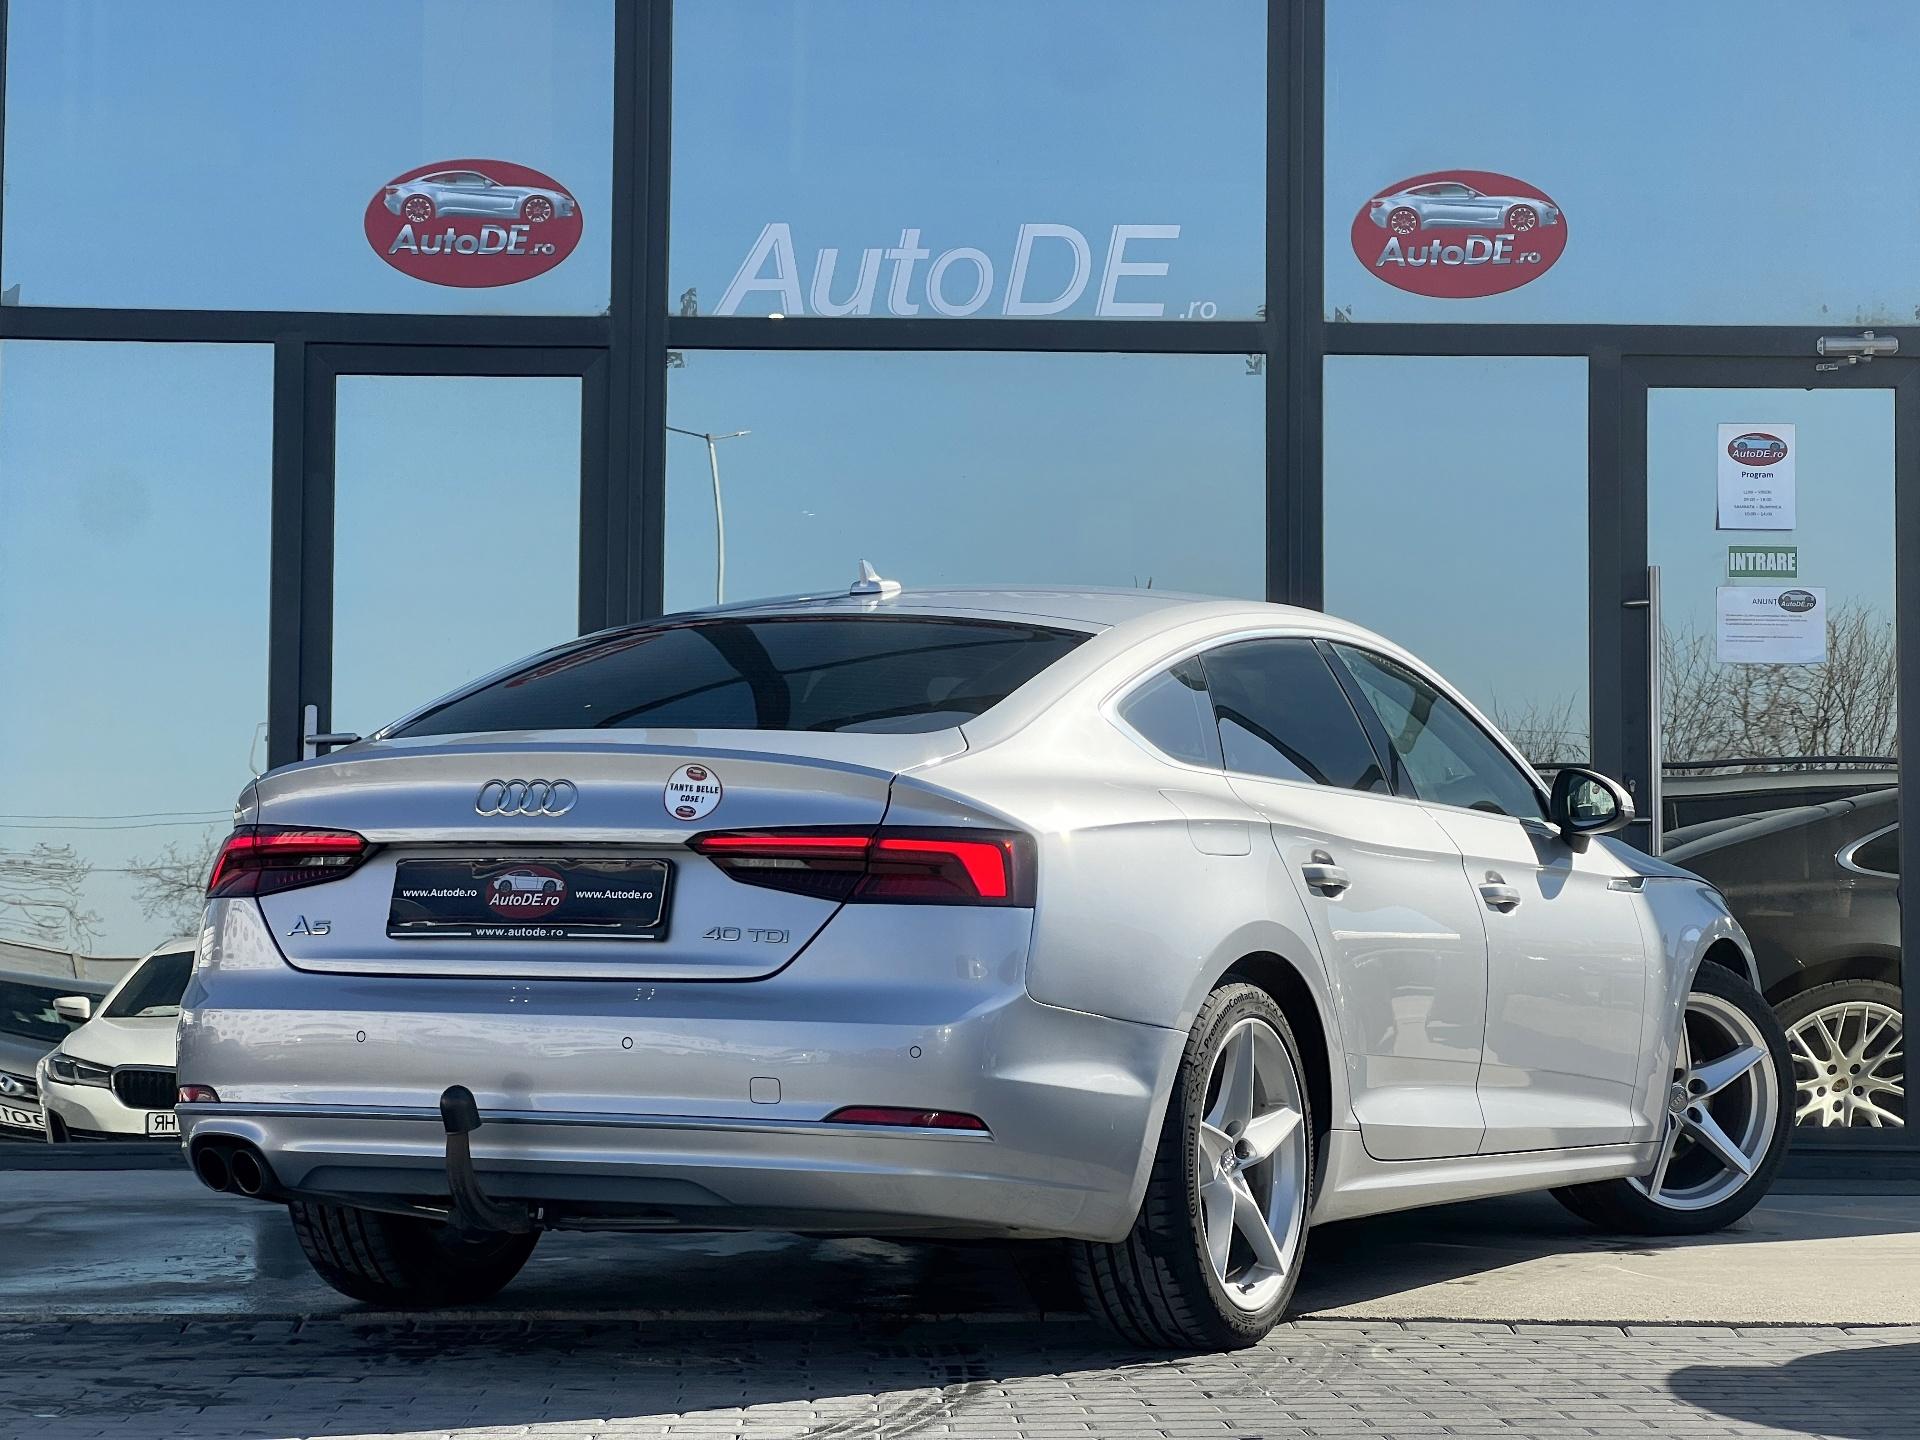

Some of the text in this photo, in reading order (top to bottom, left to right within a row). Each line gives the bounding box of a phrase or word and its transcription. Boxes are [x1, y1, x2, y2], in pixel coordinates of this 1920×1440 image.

[1741, 471, 1774, 479] Program
[1729, 552, 1796, 571] INTRARE
[670, 783, 719, 794] TANTE BELLE
[680, 794, 699, 803] COSE
[402, 888, 477, 898] www.Autode.ro
[575, 891, 653, 900] www.Autode.ro
[489, 893, 560, 907] AutoDE.ro
[287, 914, 332, 937] A5
[475, 926, 564, 938] www.autode.ro
[702, 926, 790, 944] 40 TDI
